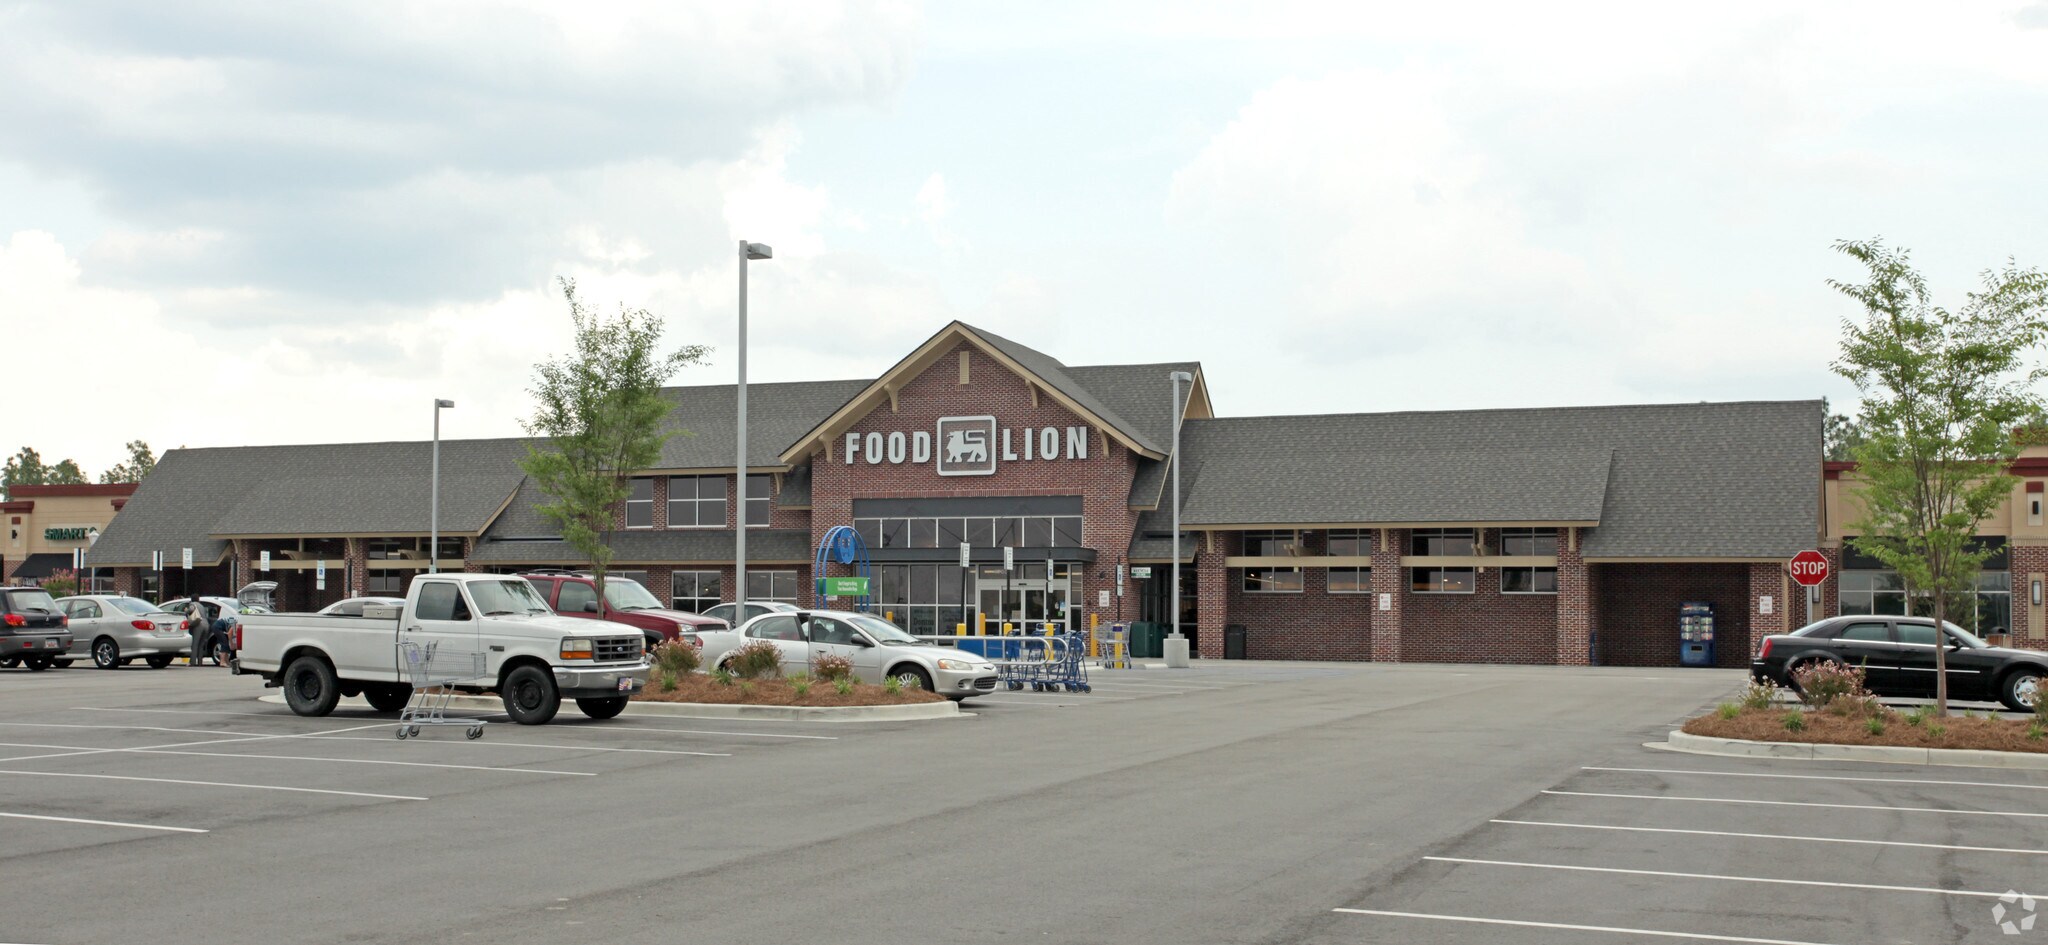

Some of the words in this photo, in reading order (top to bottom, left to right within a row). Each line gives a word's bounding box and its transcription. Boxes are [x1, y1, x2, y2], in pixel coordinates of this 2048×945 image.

[845, 431, 931, 465] FOOD
[1002, 426, 1088, 461] LION
[44, 527, 88, 540] SMART
[1793, 561, 1826, 575] STOP
